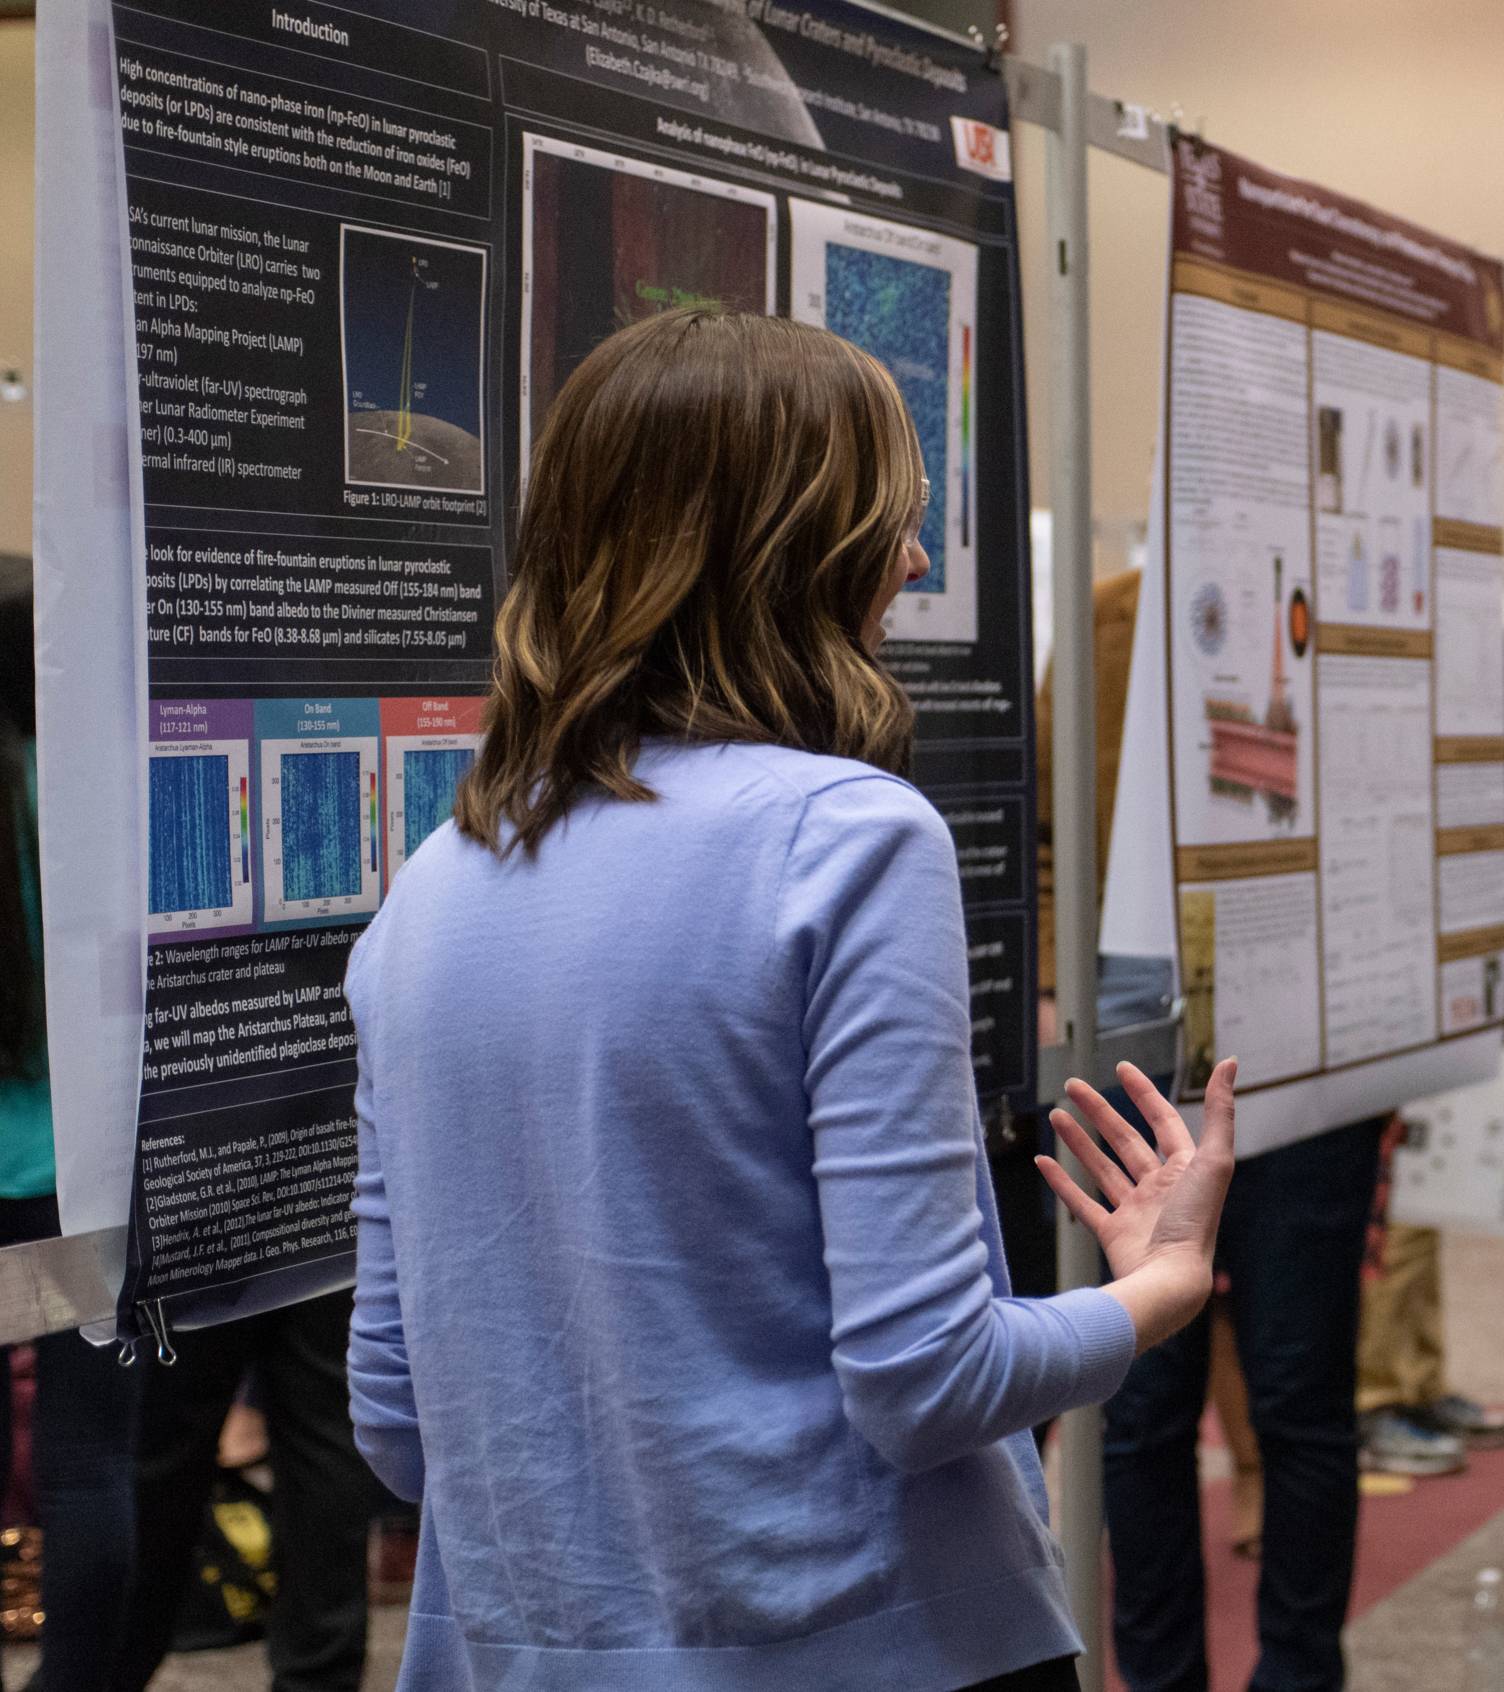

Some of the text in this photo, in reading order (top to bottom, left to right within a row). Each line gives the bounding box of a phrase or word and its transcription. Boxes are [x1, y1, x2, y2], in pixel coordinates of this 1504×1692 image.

[272, 8, 349, 46] Introduction
[119, 56, 456, 150] High concentrations of nano-phase iron (np-FeO) lunar pyroclastic
[120, 84, 471, 179] deposits (or LPDs) are consistent with the reduction iron oxides (FeO)
[121, 112, 437, 193] due to fire-fountain style eruptions both on the Moon and Earth
[150, 213, 190, 232] current
[191, 216, 219, 236] lunar
[220, 224, 261, 247] mission,
[263, 230, 280, 248] the
[282, 234, 310, 253] Lunar
[197, 244, 320, 280] Orbiter (LRO) carries two
[155, 291, 198, 312] in LPDs:
[178, 271, 315, 305] equipped to analyze np-FeO
[150, 317, 303, 356] Alpha Mapping Project (LAMP)
[156, 346, 177, 366] nm)
[201, 376, 307, 406] (far-UV) spectrograph
[155, 398, 305, 429] Lunar Radiometer Experiment
[163, 425, 208, 446] (0.3-400
[173, 453, 215, 472] infrared
[217, 456, 235, 477] (IR)
[237, 462, 302, 479] spectrometer
[343, 489, 422, 508] Figure 1: LRO-LAMP
[150, 543, 451, 576] look for evidence of fire-fountain eruptions lunar pyroclastic
[178, 571, 481, 601] (LPDs) by correlating the LAMP measured Off (155-184 nm) band
[157, 598, 478, 622] On (130-155 nm) band albedo the Diviner measured Christiansen
[172, 624, 194, 645] (CF)
[199, 625, 232, 642] bands
[233, 625, 250, 642] for
[251, 627, 272, 643] FeO
[273, 626, 321, 646] (8.38-8.68
[343, 628, 362, 644] and
[363, 629, 400, 645] silicates
[401, 629, 447, 648] (7.55-8.05
[159, 703, 207, 717] Lyman-Alpha
[159, 720, 208, 735] (117-121 nm)
[154, 930, 348, 966] 2: Wavelength ranges for LAMP far-UV albedo
[156, 961, 285, 989] Aristarchus crater and plateau
[155, 982, 341, 1025] far-UV albedos measured by LAMP and
[153, 1006, 347, 1050] we will map the Aristarchus Plateau, and
[143, 1063, 158, 1081] the
[160, 1053, 214, 1081] previously
[215, 1042, 277, 1068] unidentified
[278, 1036, 326, 1061] plagioclase
